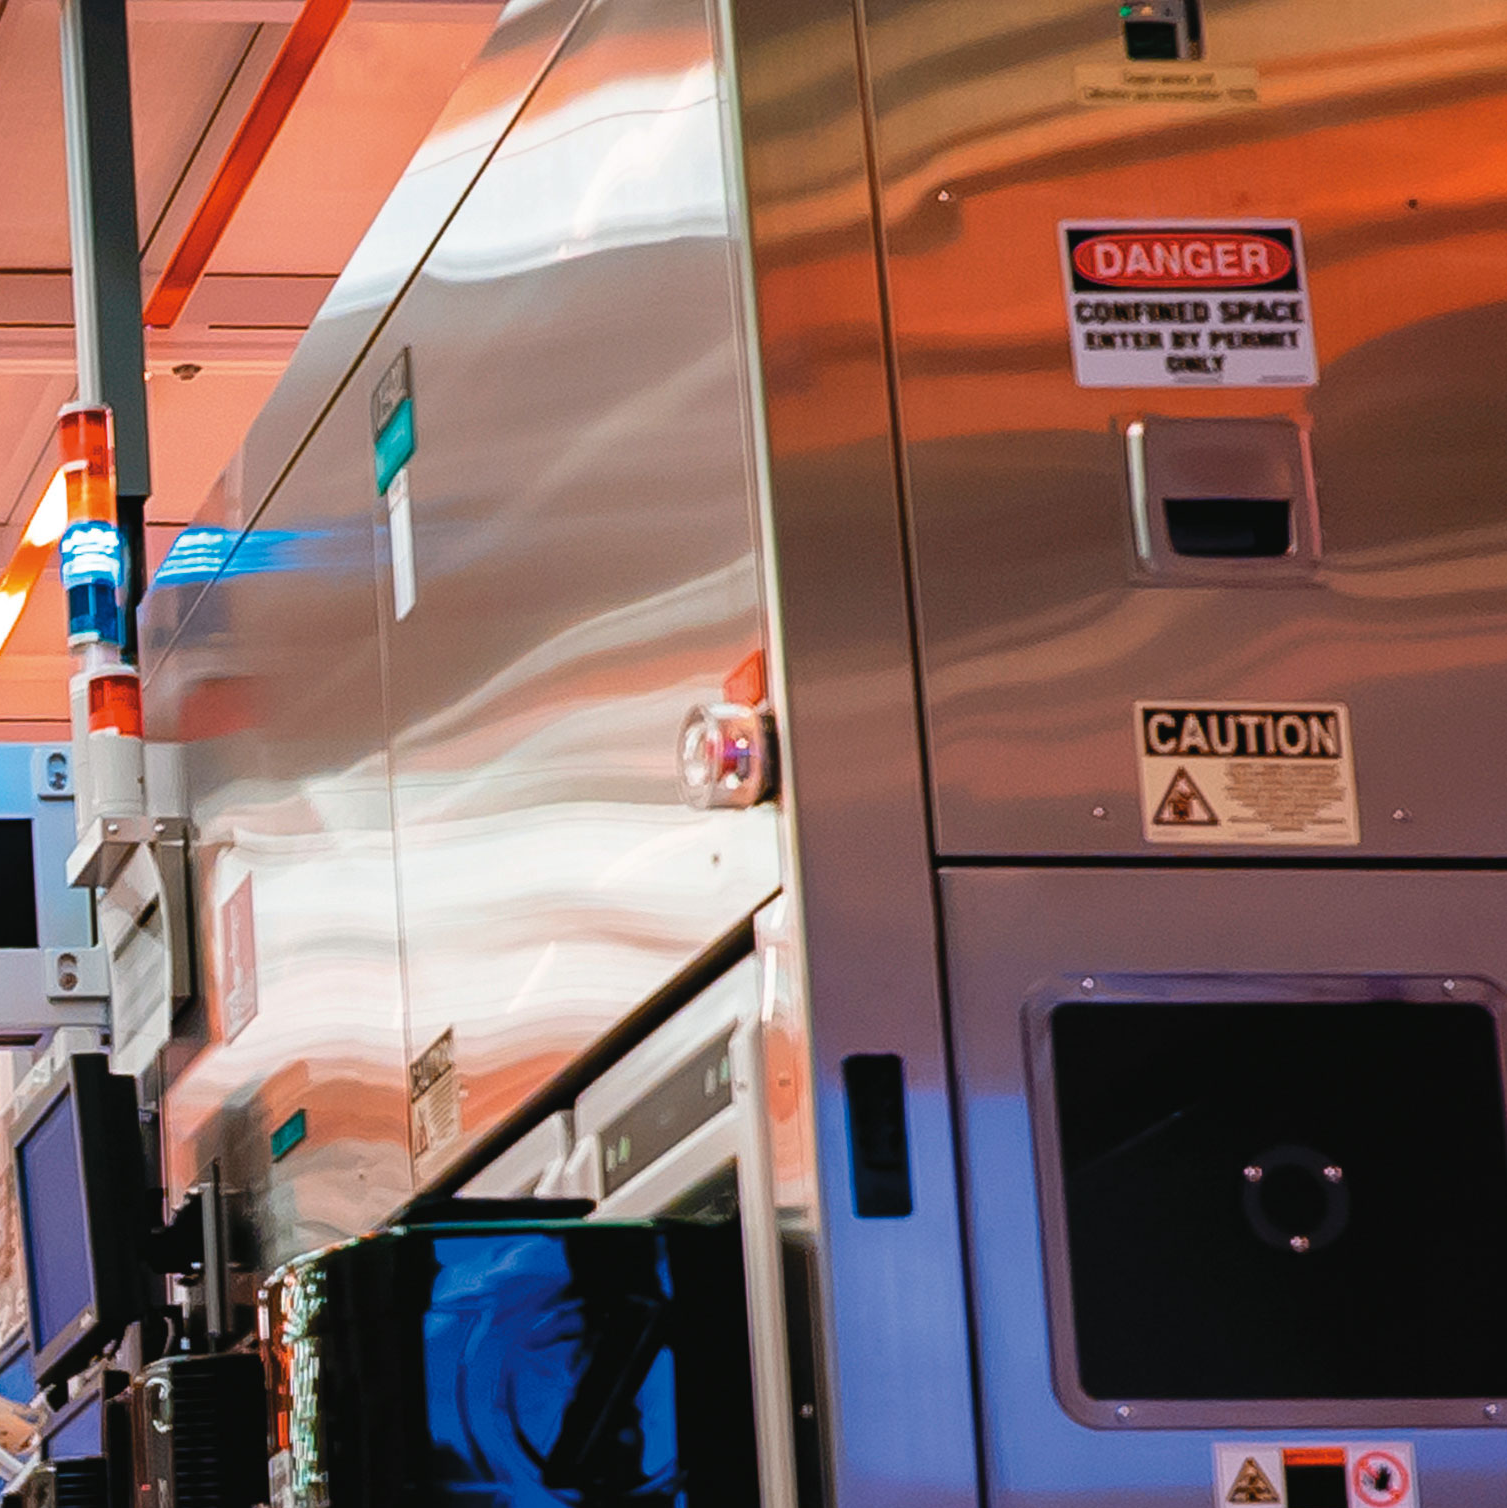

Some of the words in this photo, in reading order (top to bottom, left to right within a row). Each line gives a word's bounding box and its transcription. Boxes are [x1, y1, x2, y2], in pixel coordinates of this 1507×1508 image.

[1093, 241, 1270, 278] DANGER
[1076, 301, 1210, 324] CONFINED
[1219, 301, 1303, 323] SPACE
[1085, 331, 1163, 350] ENTER
[1147, 713, 1336, 755] CAUTION
